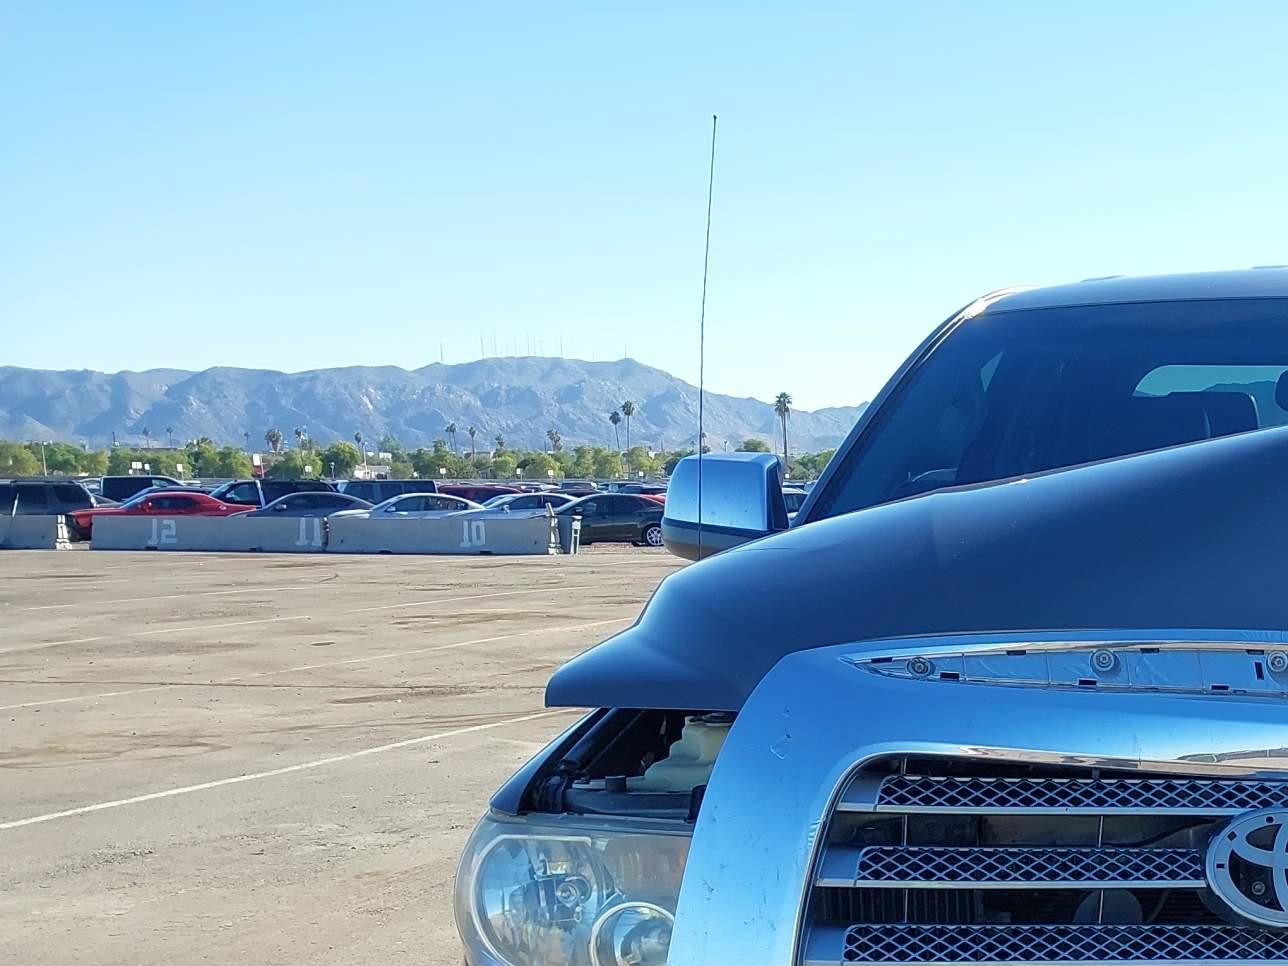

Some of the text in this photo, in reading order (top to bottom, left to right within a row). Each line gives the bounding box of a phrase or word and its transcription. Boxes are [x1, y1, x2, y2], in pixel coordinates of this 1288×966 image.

[147, 518, 178, 545] 12
[295, 517, 322, 546] 11
[459, 520, 486, 547] 10
